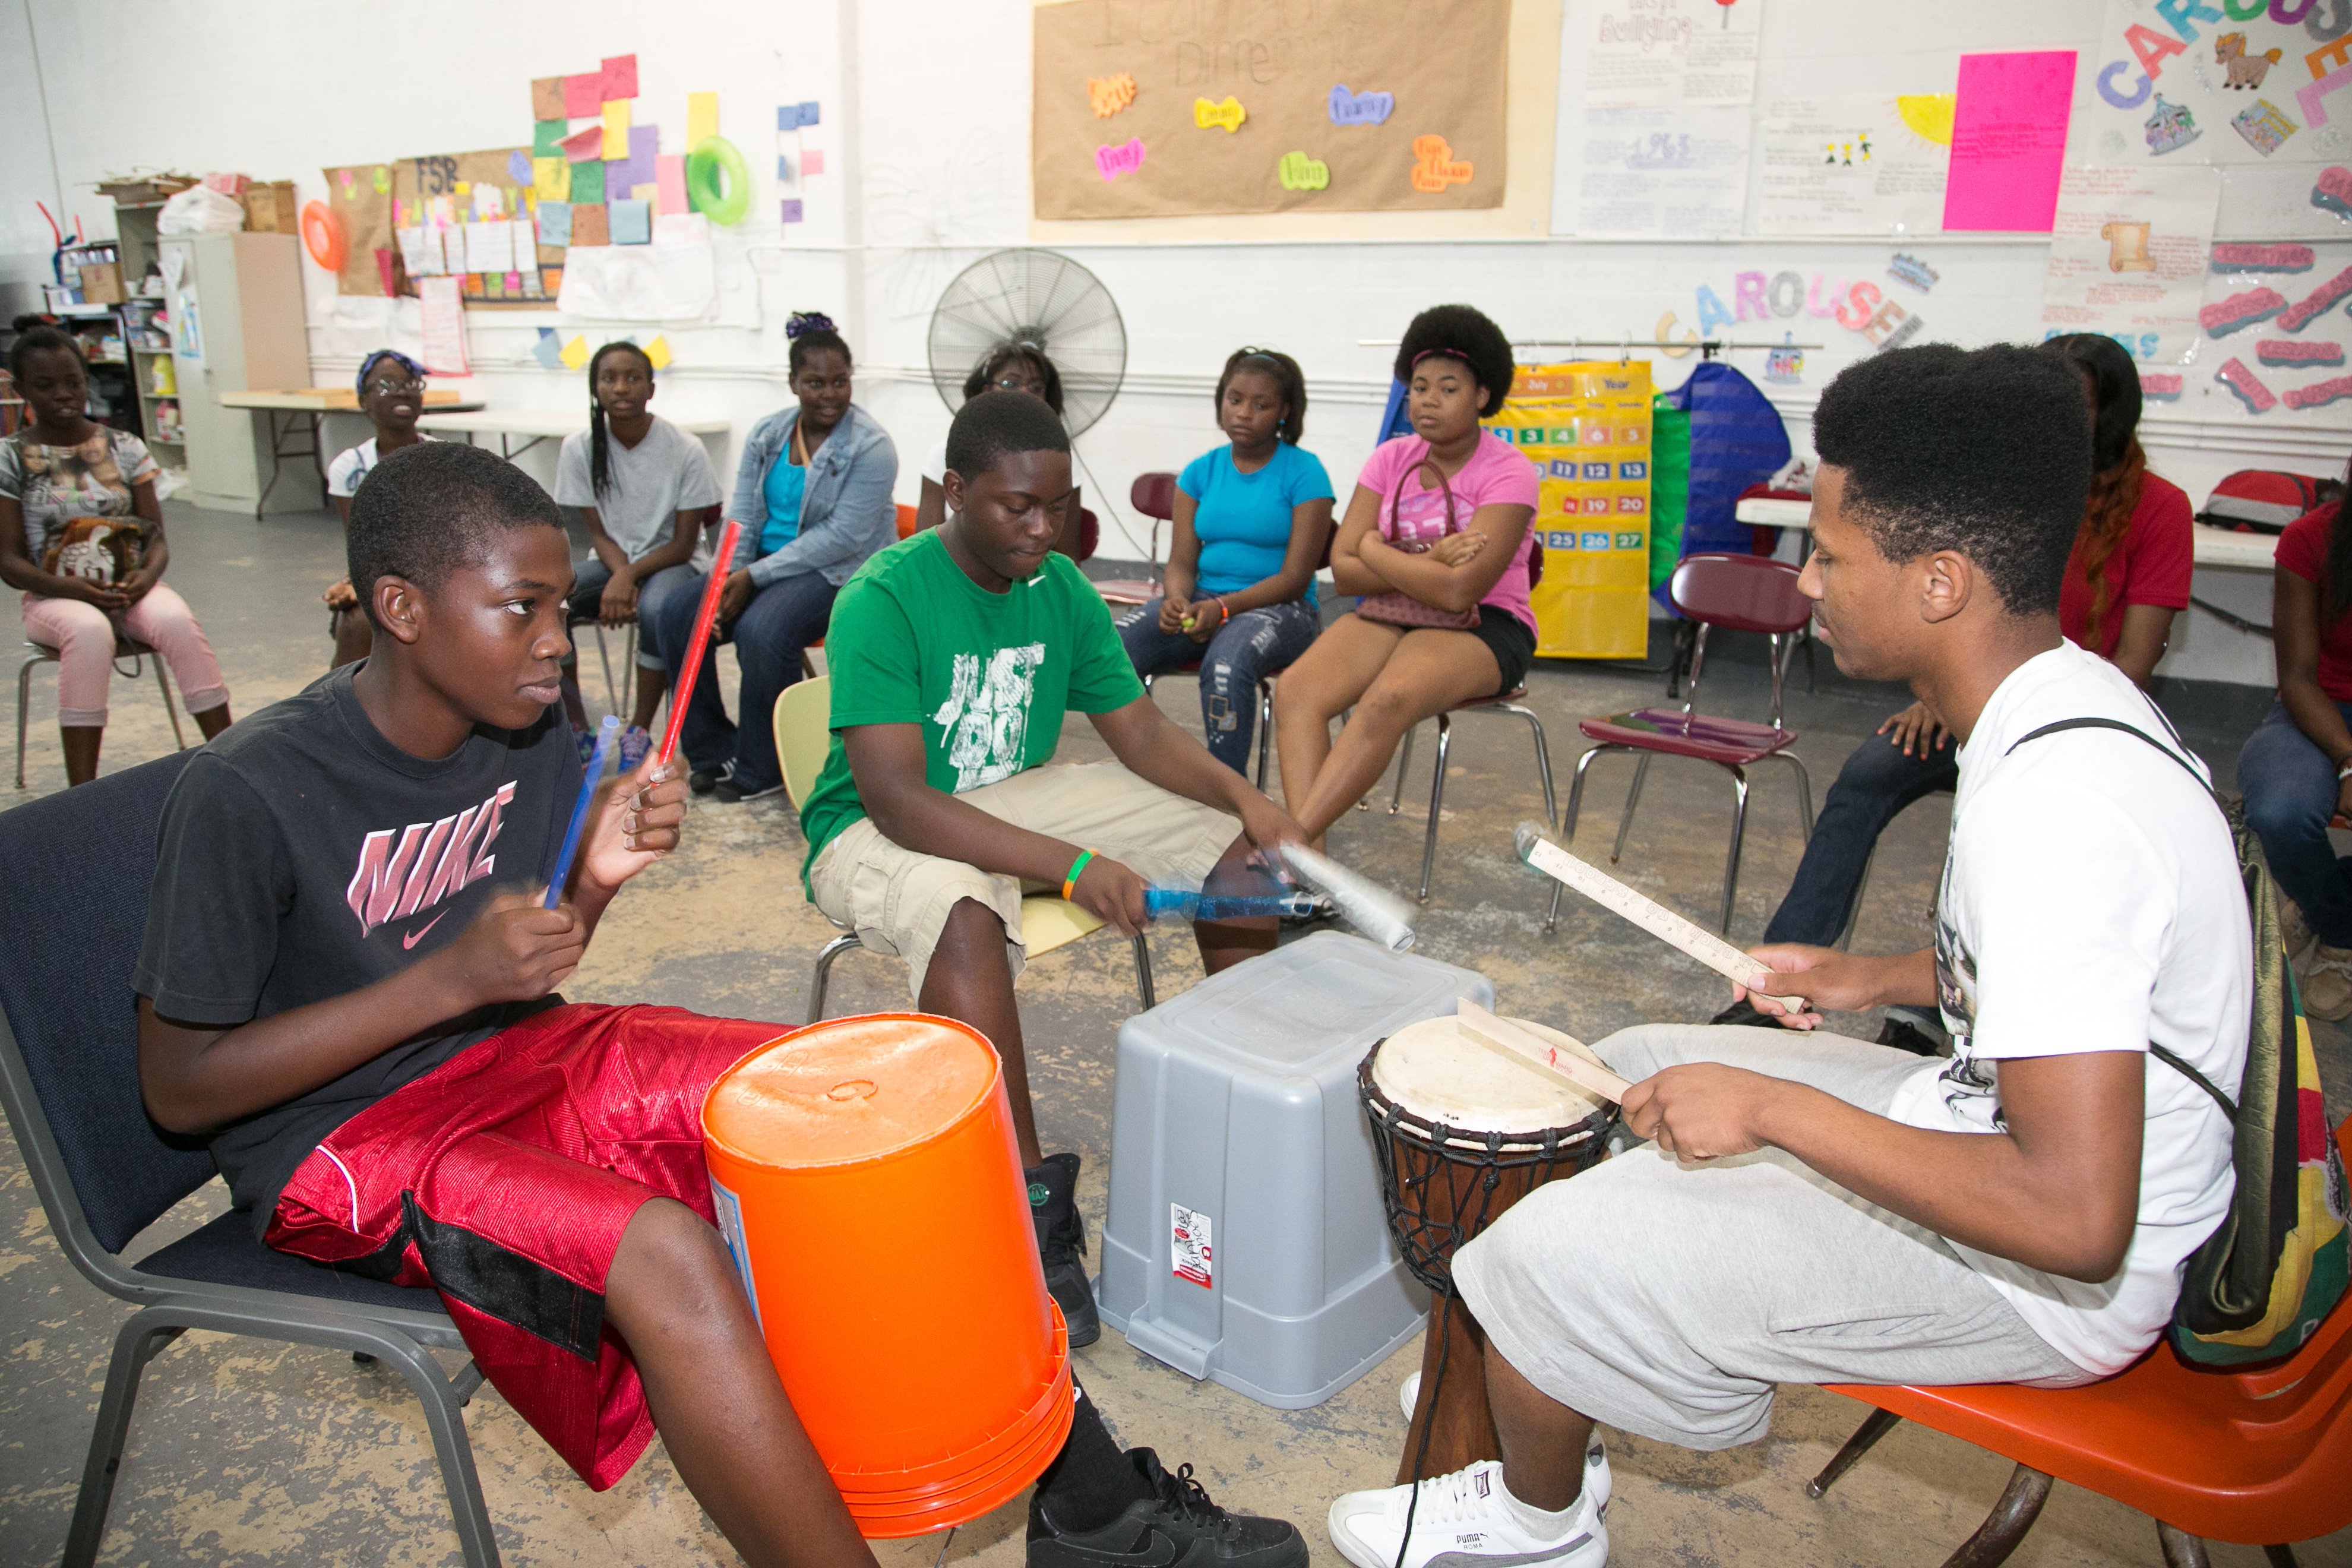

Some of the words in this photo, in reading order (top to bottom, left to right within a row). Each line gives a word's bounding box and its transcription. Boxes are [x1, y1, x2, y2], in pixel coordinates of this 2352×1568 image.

[1526, 429, 1538, 442] 3
[1557, 430, 1569, 442] 4
[1557, 462, 1572, 476] 11
[1587, 464, 1607, 477] 12
[1624, 463, 1643, 476] 13
[1587, 499, 1607, 511] 19
[1620, 498, 1643, 511] 20
[1552, 535, 1574, 547] 25
[1585, 535, 1607, 547] 26
[1618, 535, 1641, 546] 27
[347, 780, 517, 938] NIKE
[1534, 850, 1542, 858] 12
[1564, 855, 1629, 899] SCHOOL
[1646, 902, 1670, 922] TO
[1689, 925, 1735, 960] BACK
[1556, 1061, 1573, 1074] WARD
[1456, 1533, 1480, 1544] PUMA
